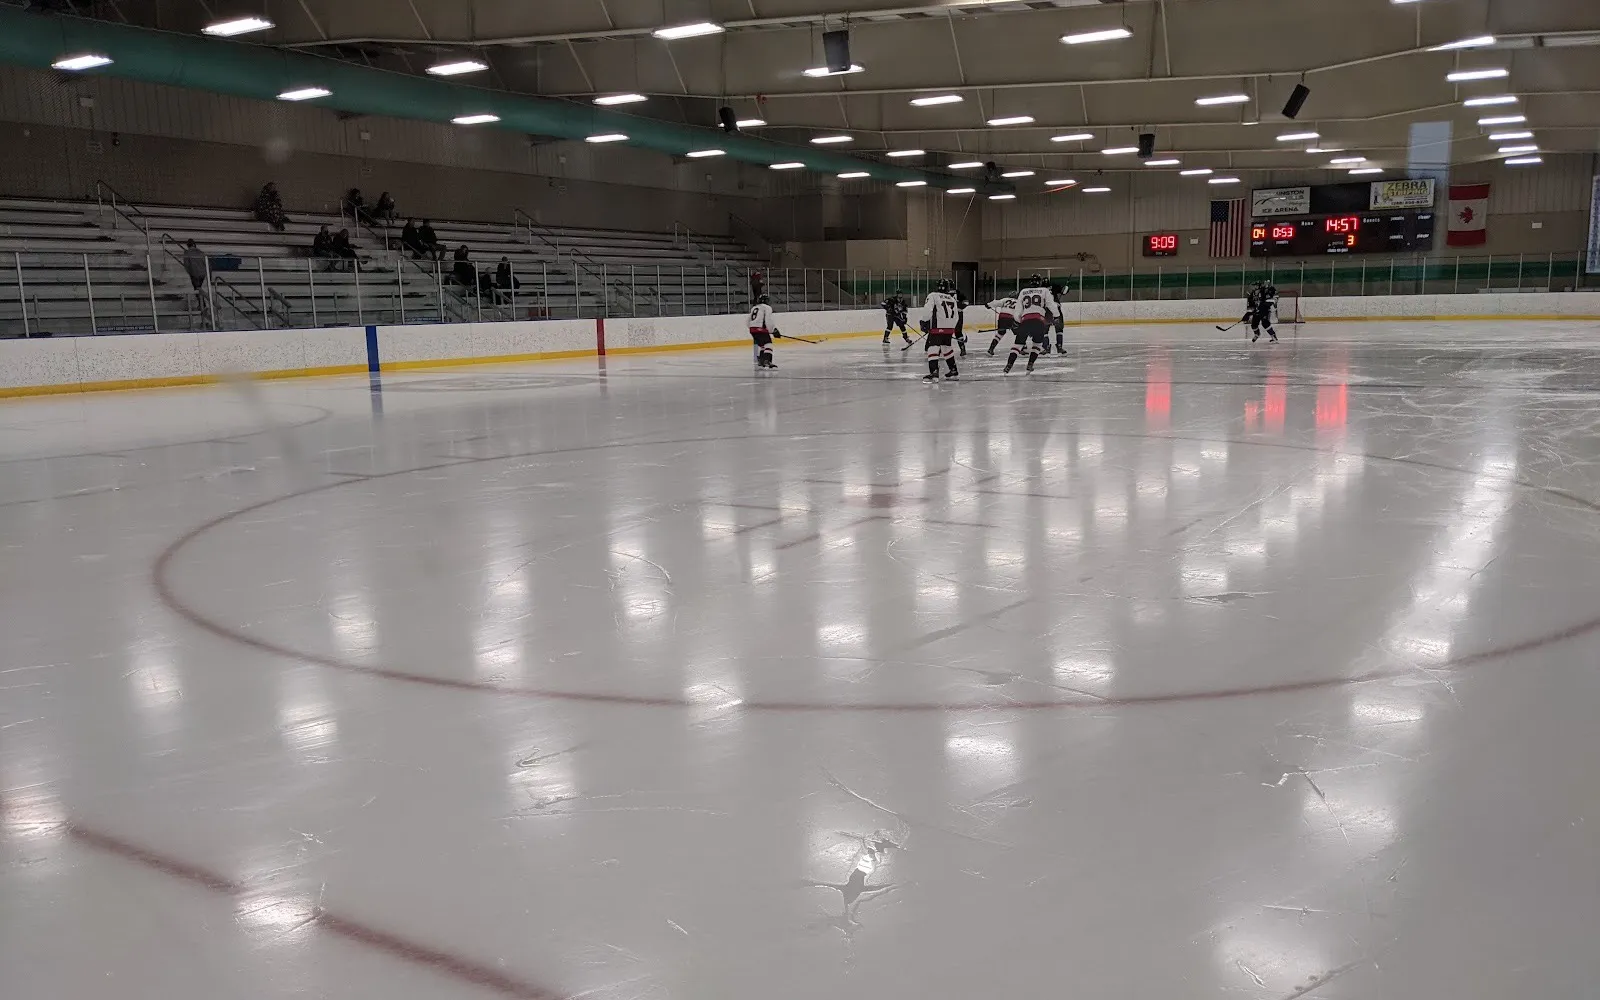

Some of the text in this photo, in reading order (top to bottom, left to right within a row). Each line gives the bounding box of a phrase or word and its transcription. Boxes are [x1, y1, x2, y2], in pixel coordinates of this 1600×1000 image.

[1387, 181, 1427, 191] ZEBRA
[1326, 218, 1357, 232] 14:57
[1253, 229, 1265, 239] 04
[1272, 227, 1293, 238] 0:53
[1151, 236, 1175, 249] 9:09
[1347, 235, 1354, 245] 3
[751, 308, 759, 321] 8
[941, 301, 954, 318] 17
